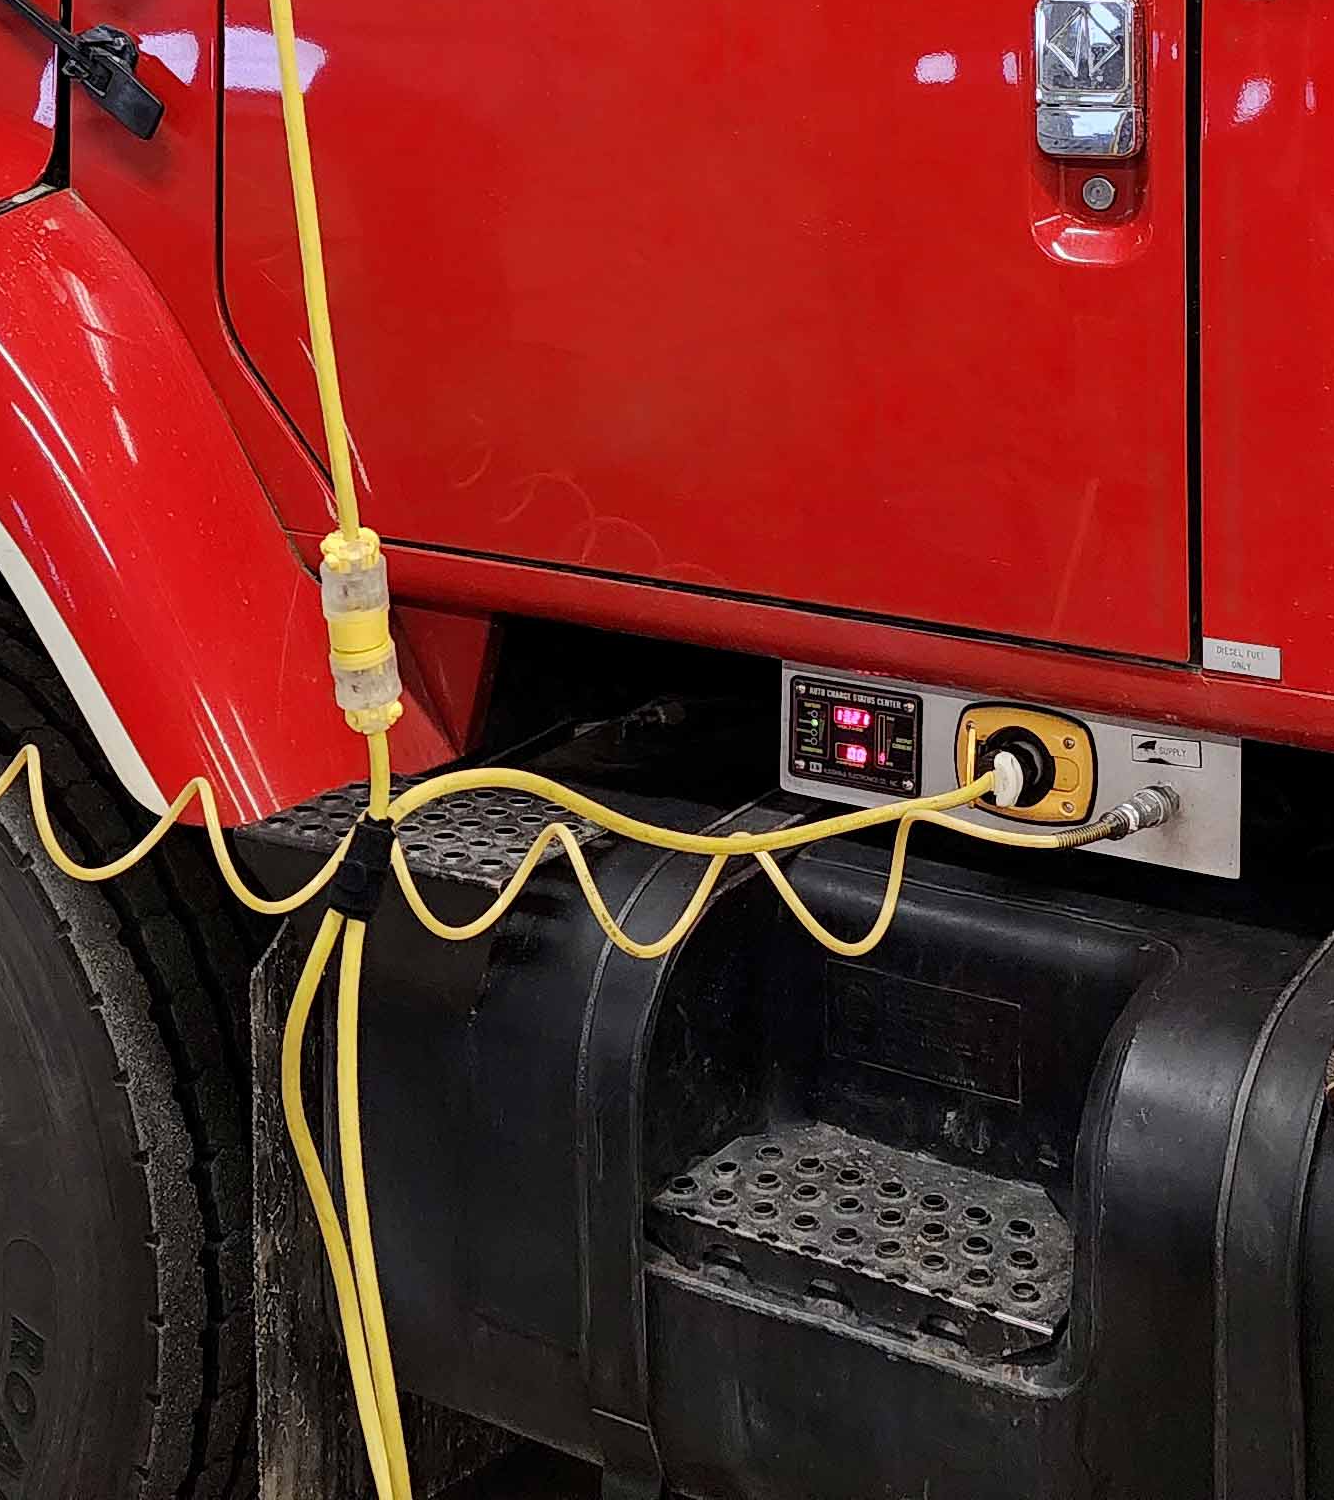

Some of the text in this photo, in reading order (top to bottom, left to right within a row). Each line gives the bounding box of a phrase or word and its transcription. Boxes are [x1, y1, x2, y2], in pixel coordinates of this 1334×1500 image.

[1216, 645, 1265, 660] DIESEL FUEL
[1231, 661, 1251, 671] ONLY
[809, 686, 902, 709] AUTO CHARGE STATUS CENTER
[1159, 747, 1187, 758] SUPPLY
